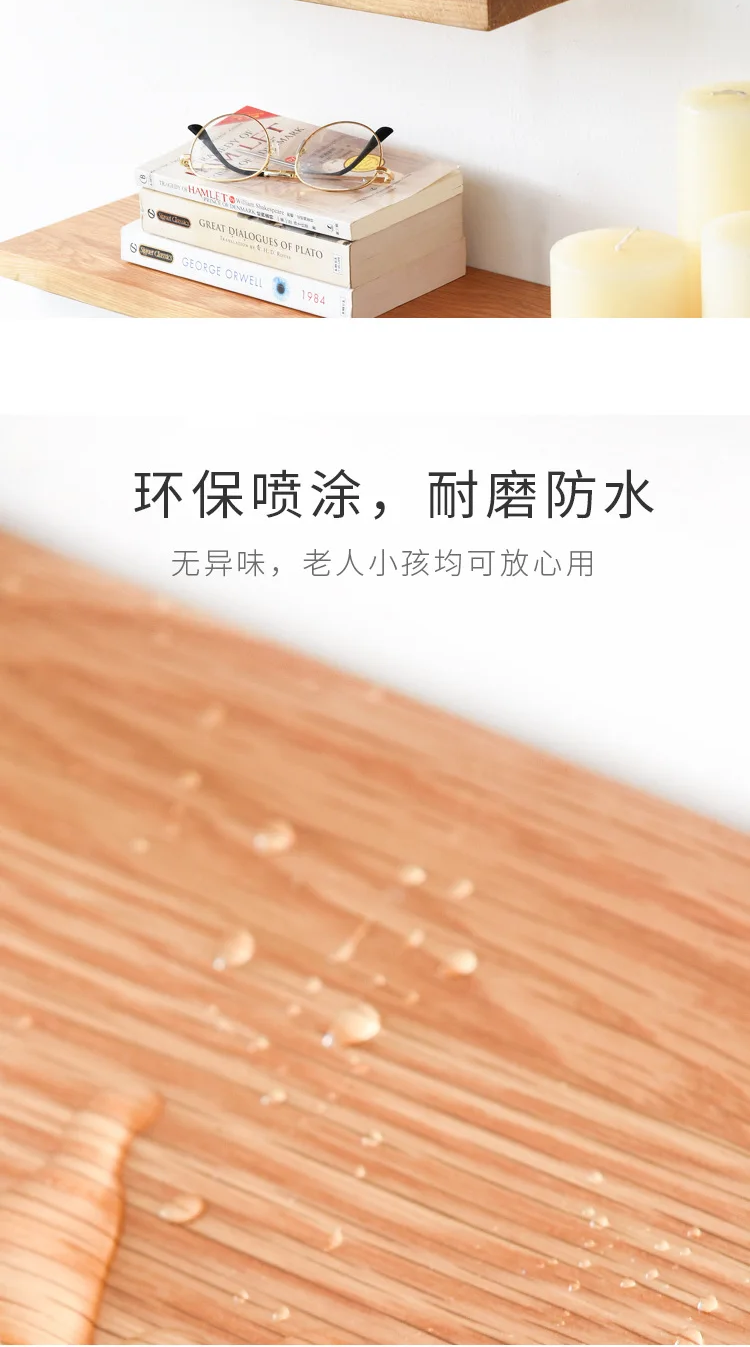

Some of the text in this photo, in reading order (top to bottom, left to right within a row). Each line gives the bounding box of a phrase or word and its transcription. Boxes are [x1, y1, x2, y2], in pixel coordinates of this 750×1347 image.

[188, 184, 229, 203] HAMLET
[199, 218, 323, 260] GREAT DIALOGUES OF PLATO
[182, 257, 263, 288] GEORGE ORWELL
[302, 289, 326, 305] 1984
